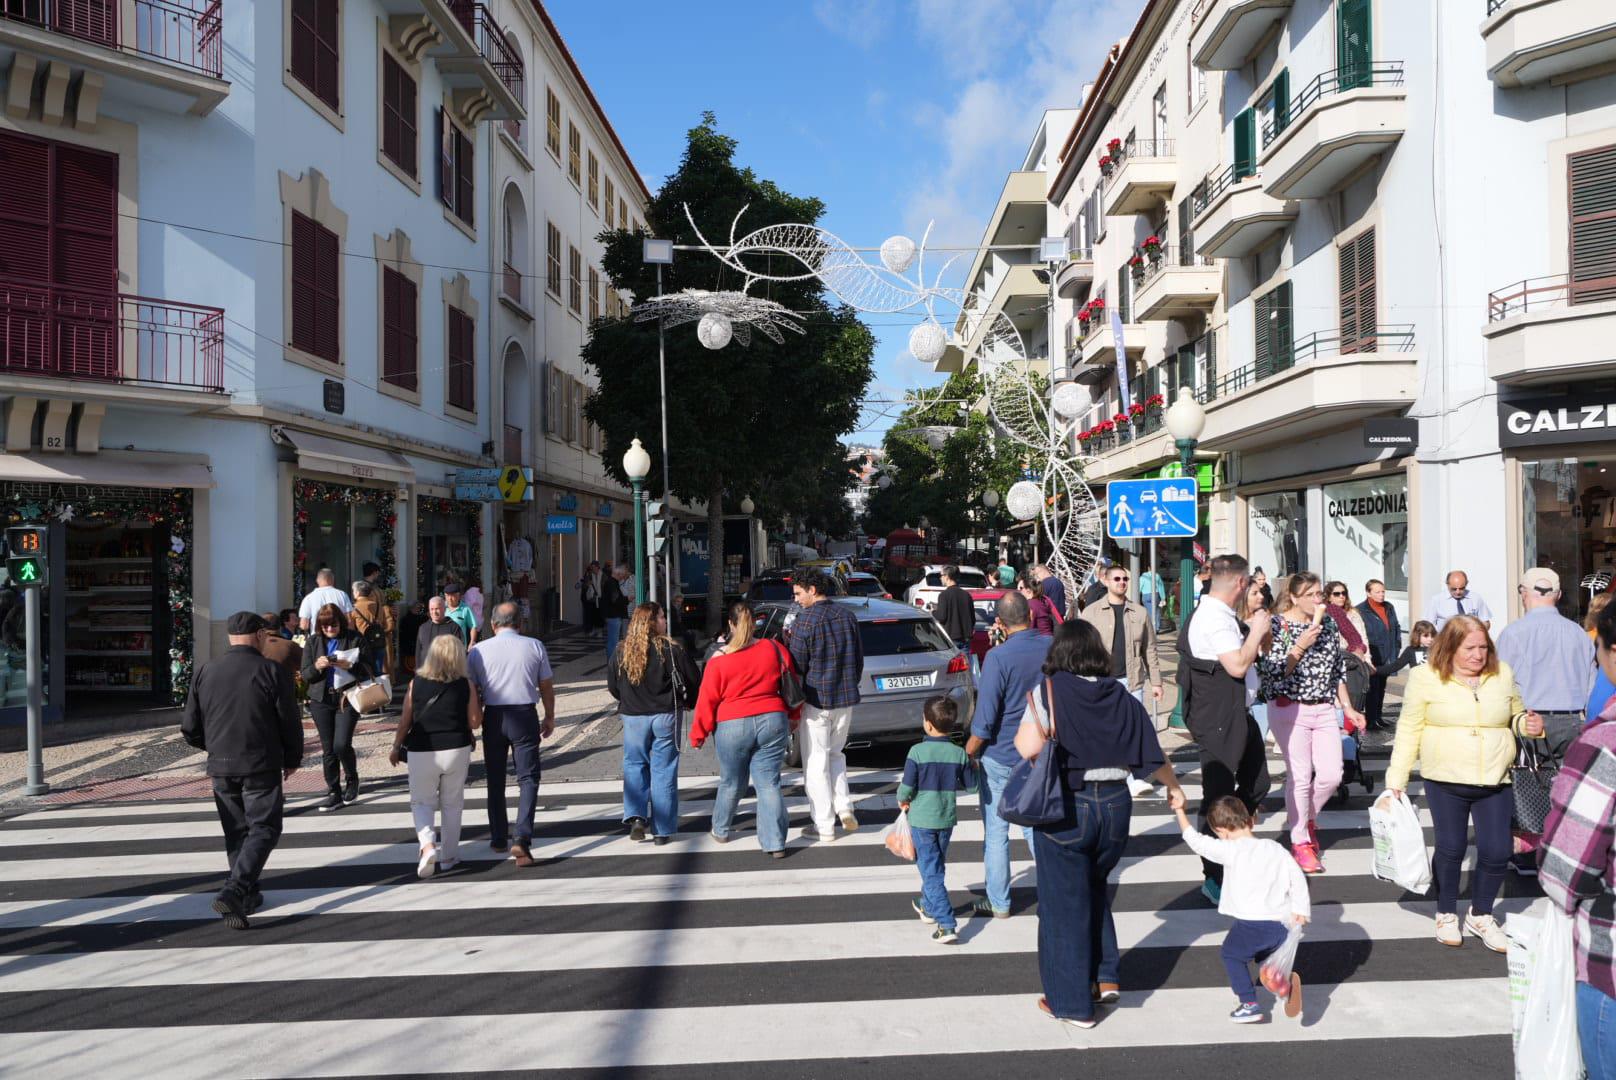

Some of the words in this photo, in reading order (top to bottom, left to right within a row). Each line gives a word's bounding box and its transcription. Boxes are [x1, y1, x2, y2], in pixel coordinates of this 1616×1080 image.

[47, 436, 61, 447] 82
[1328, 493, 1408, 518] CALZEDONIA
[23, 533, 39, 550] 13
